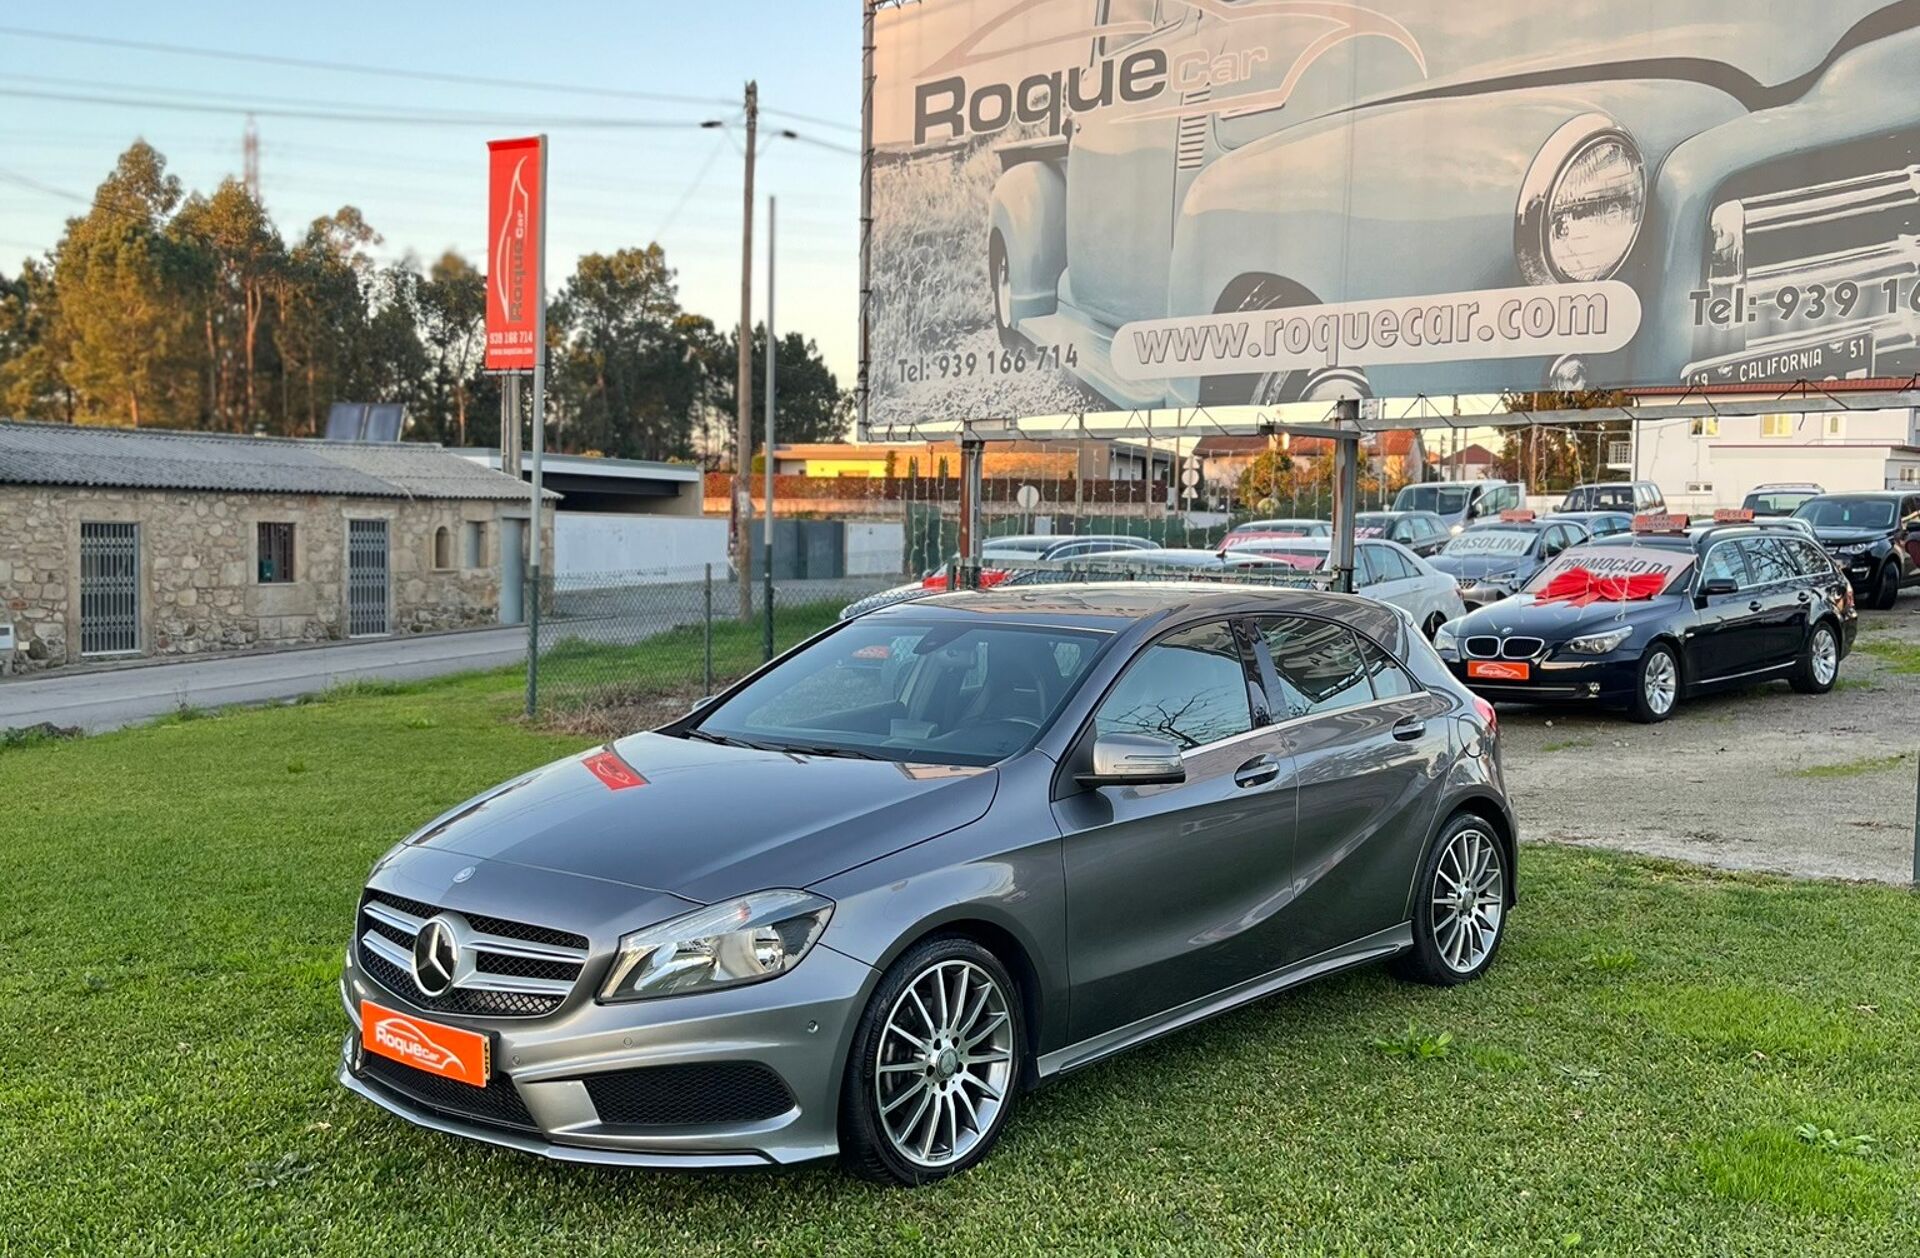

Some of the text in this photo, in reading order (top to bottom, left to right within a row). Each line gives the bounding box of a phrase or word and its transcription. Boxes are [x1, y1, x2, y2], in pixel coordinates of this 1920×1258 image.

[1689, 287, 1757, 326] Tel:
[1776, 281, 1859, 320] 939
[1133, 292, 1608, 367] www.roquecar.com
[898, 343, 1078, 383] Tel: 939 166 714
[1739, 348, 1822, 382] CALIFORNIA
[1850, 339, 1865, 359] 51
[1449, 537, 1526, 552] GASOLINA
